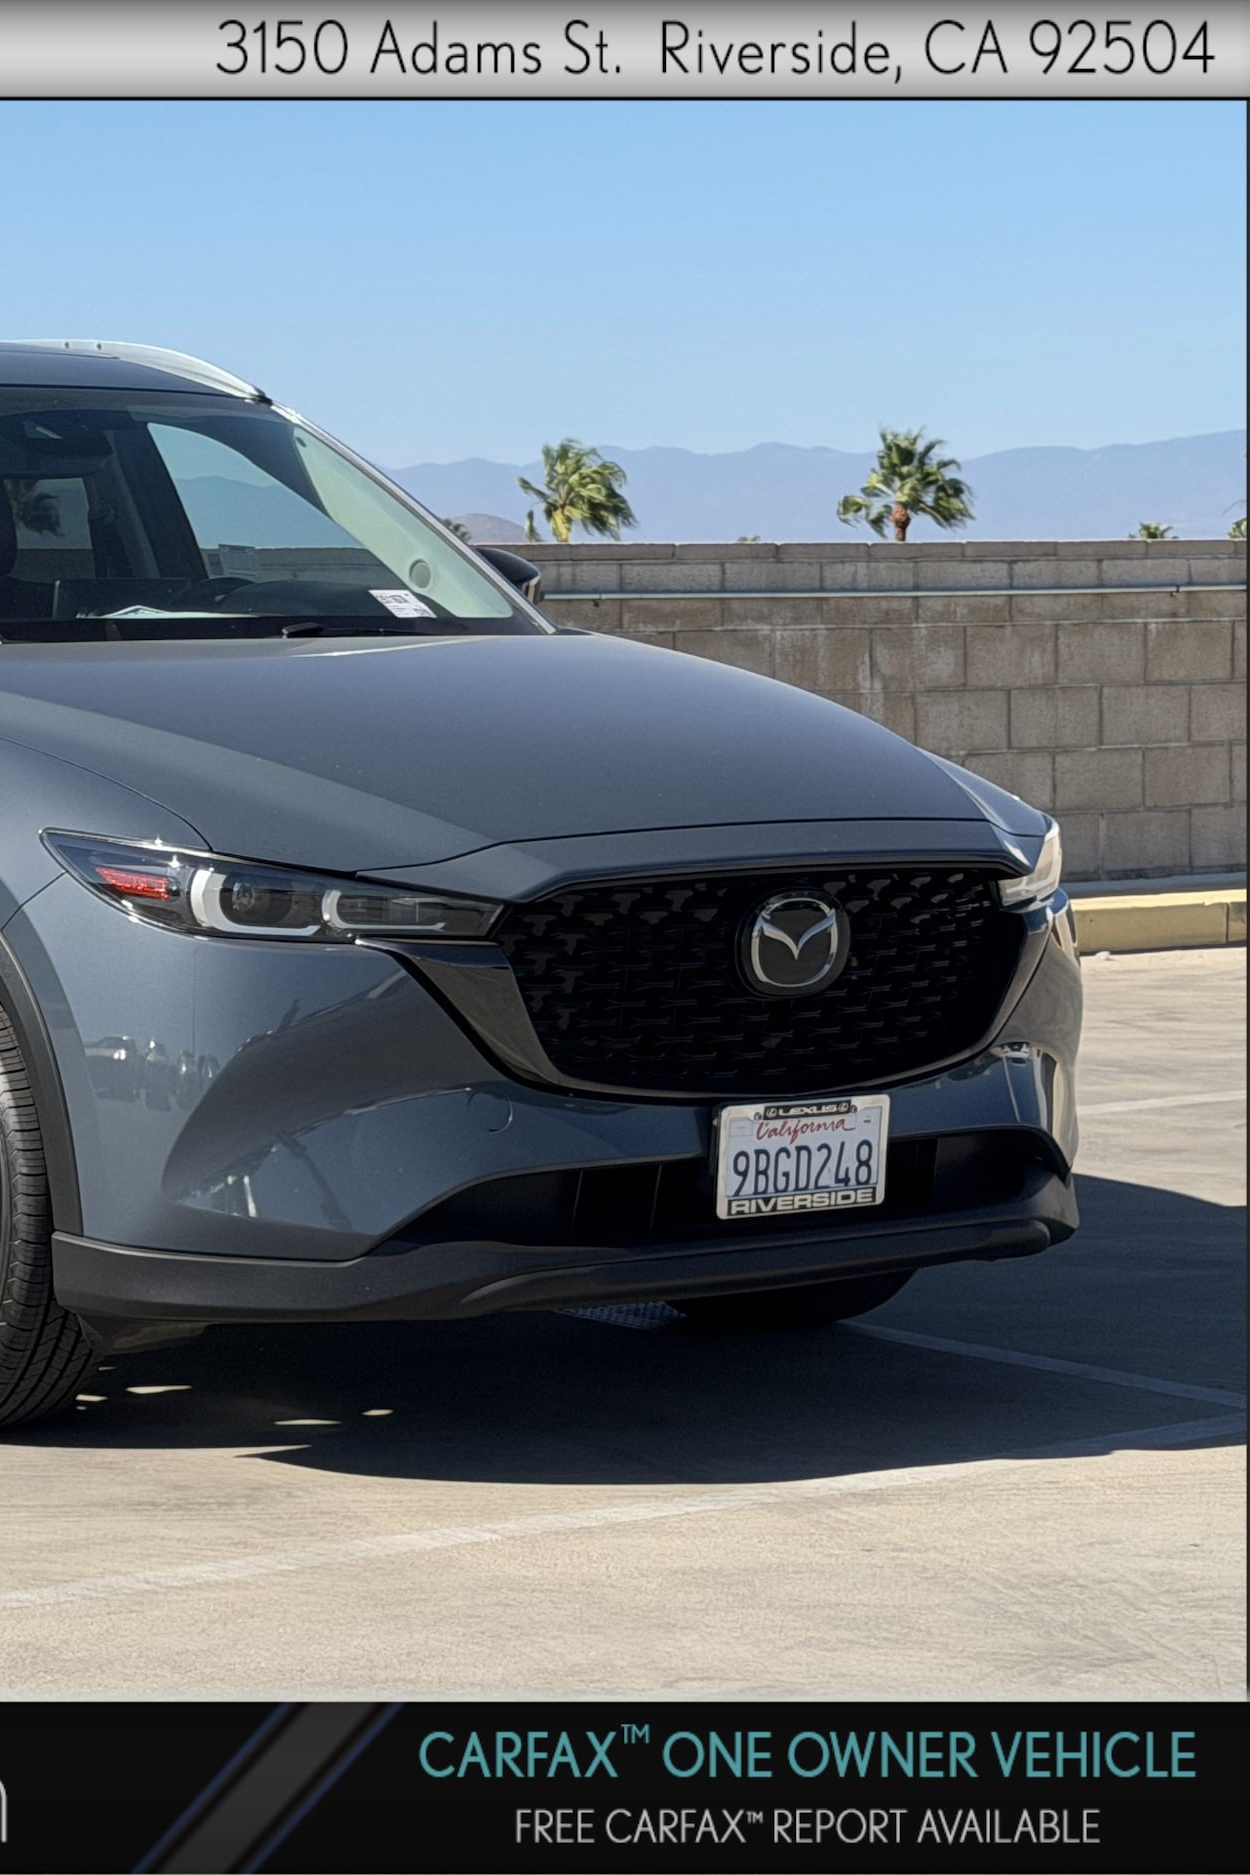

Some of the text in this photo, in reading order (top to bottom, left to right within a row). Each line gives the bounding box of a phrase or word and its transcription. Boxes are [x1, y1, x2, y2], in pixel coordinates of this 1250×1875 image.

[778, 1103, 839, 1117] LEXUS
[755, 1118, 856, 1145] California
[732, 1138, 874, 1198] 9BGD248
[730, 1187, 874, 1216] RIVERSIDE
